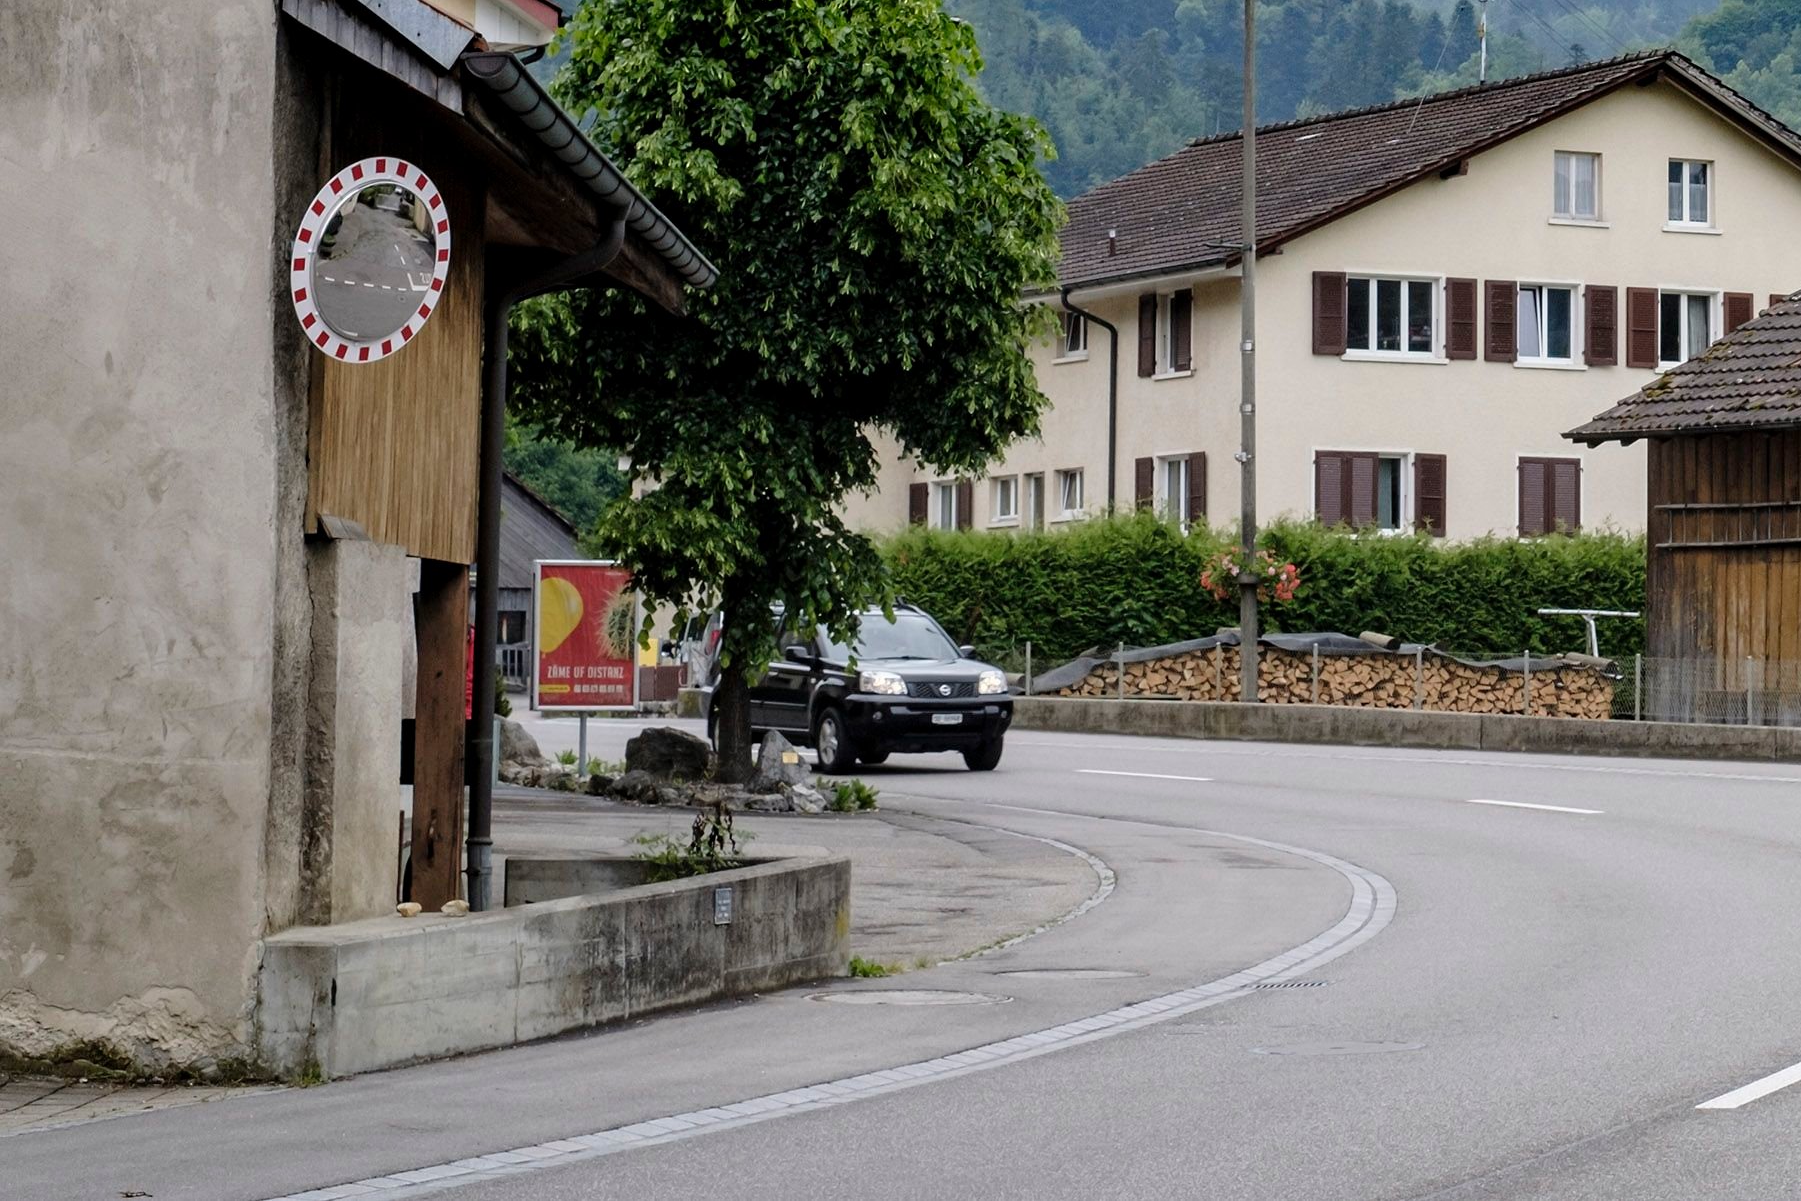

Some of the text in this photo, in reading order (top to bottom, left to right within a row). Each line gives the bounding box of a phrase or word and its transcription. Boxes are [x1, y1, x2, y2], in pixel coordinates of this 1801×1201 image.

[547, 664, 624, 679] ZÄME UF DISTANZ
